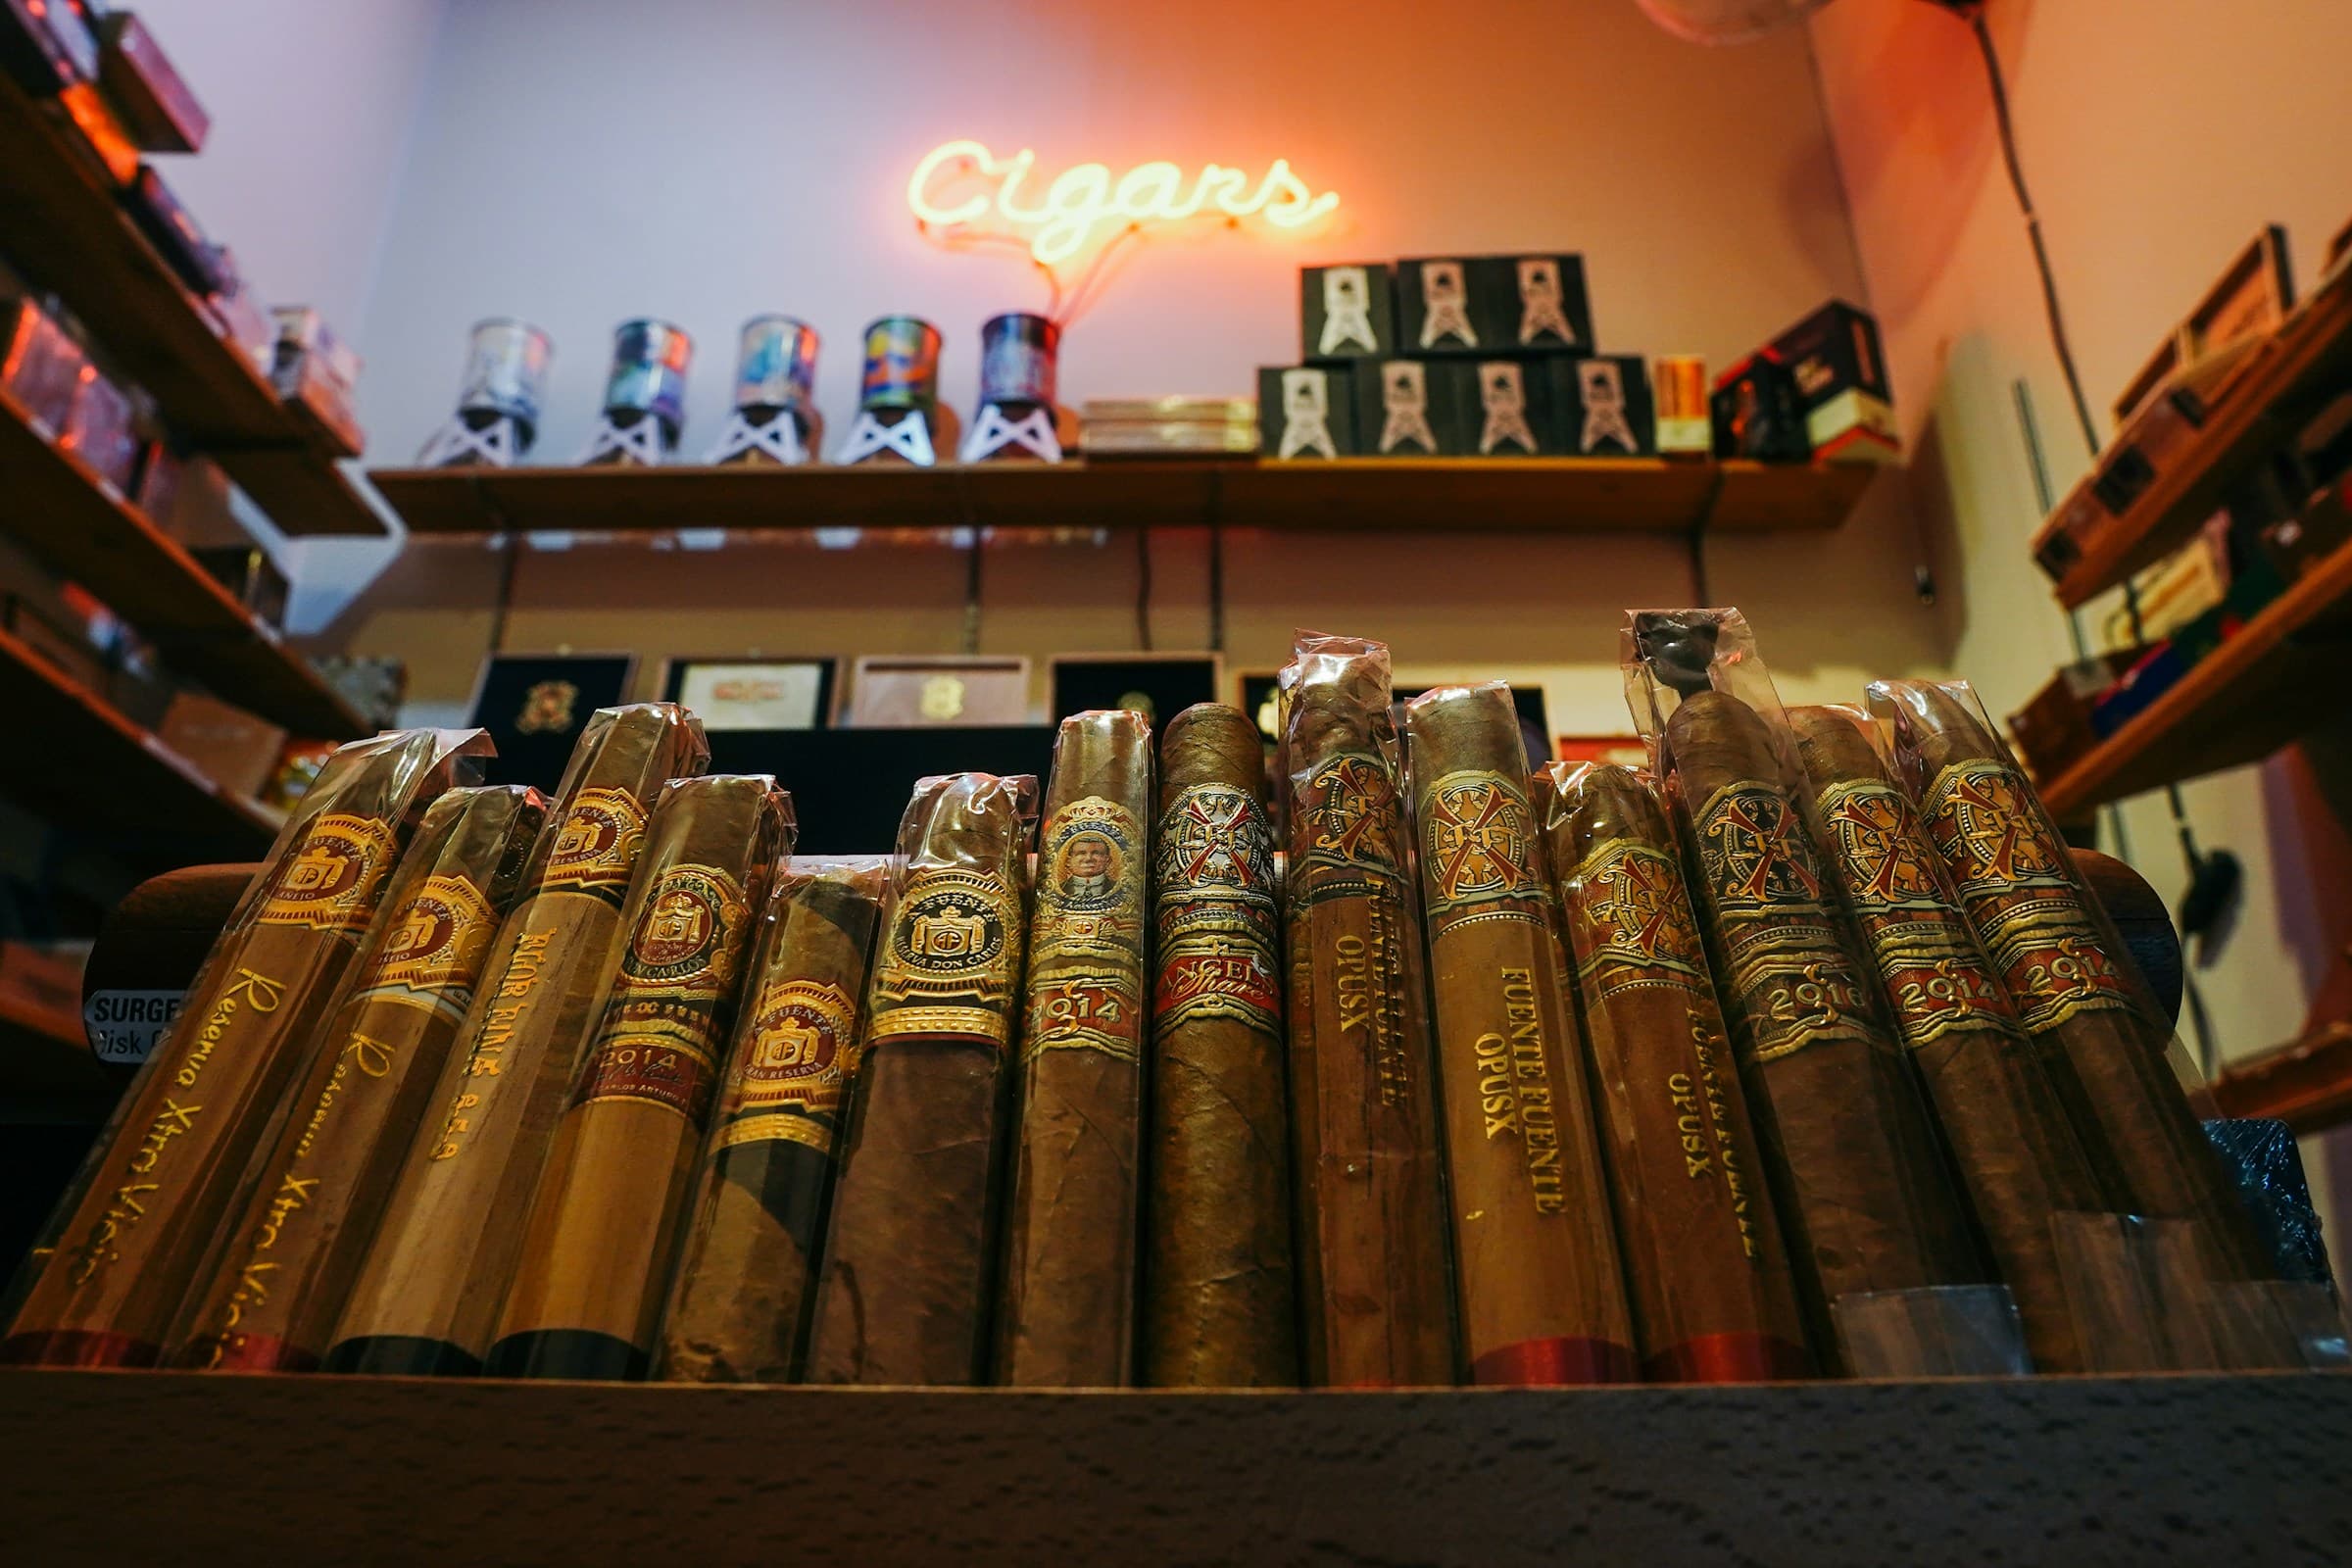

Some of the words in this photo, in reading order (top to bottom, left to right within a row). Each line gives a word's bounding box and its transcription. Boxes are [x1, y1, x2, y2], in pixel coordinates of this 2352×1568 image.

[907, 139, 1339, 265] Cigars
[921, 894, 999, 922] FUENTE
[647, 956, 707, 976] CARLOS
[930, 959, 963, 969] DON
[965, 935, 1003, 966] CARLOS
[1336, 934, 1370, 1033] OPUSX
[2023, 956, 2122, 993] 2014
[94, 997, 181, 1022] SURGE
[1897, 977, 2001, 1011] 2014
[767, 1005, 833, 1035] FUENTE
[1031, 997, 1122, 1026] 2014
[1501, 967, 1546, 1078] FUENTE
[599, 1049, 677, 1071] 2014
[744, 1063, 765, 1079] GRAN
[769, 1061, 823, 1079] RESERVA
[1474, 1033, 1518, 1140] OPUSX
[1669, 1073, 1713, 1178] OPUSX
[1519, 1085, 1566, 1214] FUENTE
